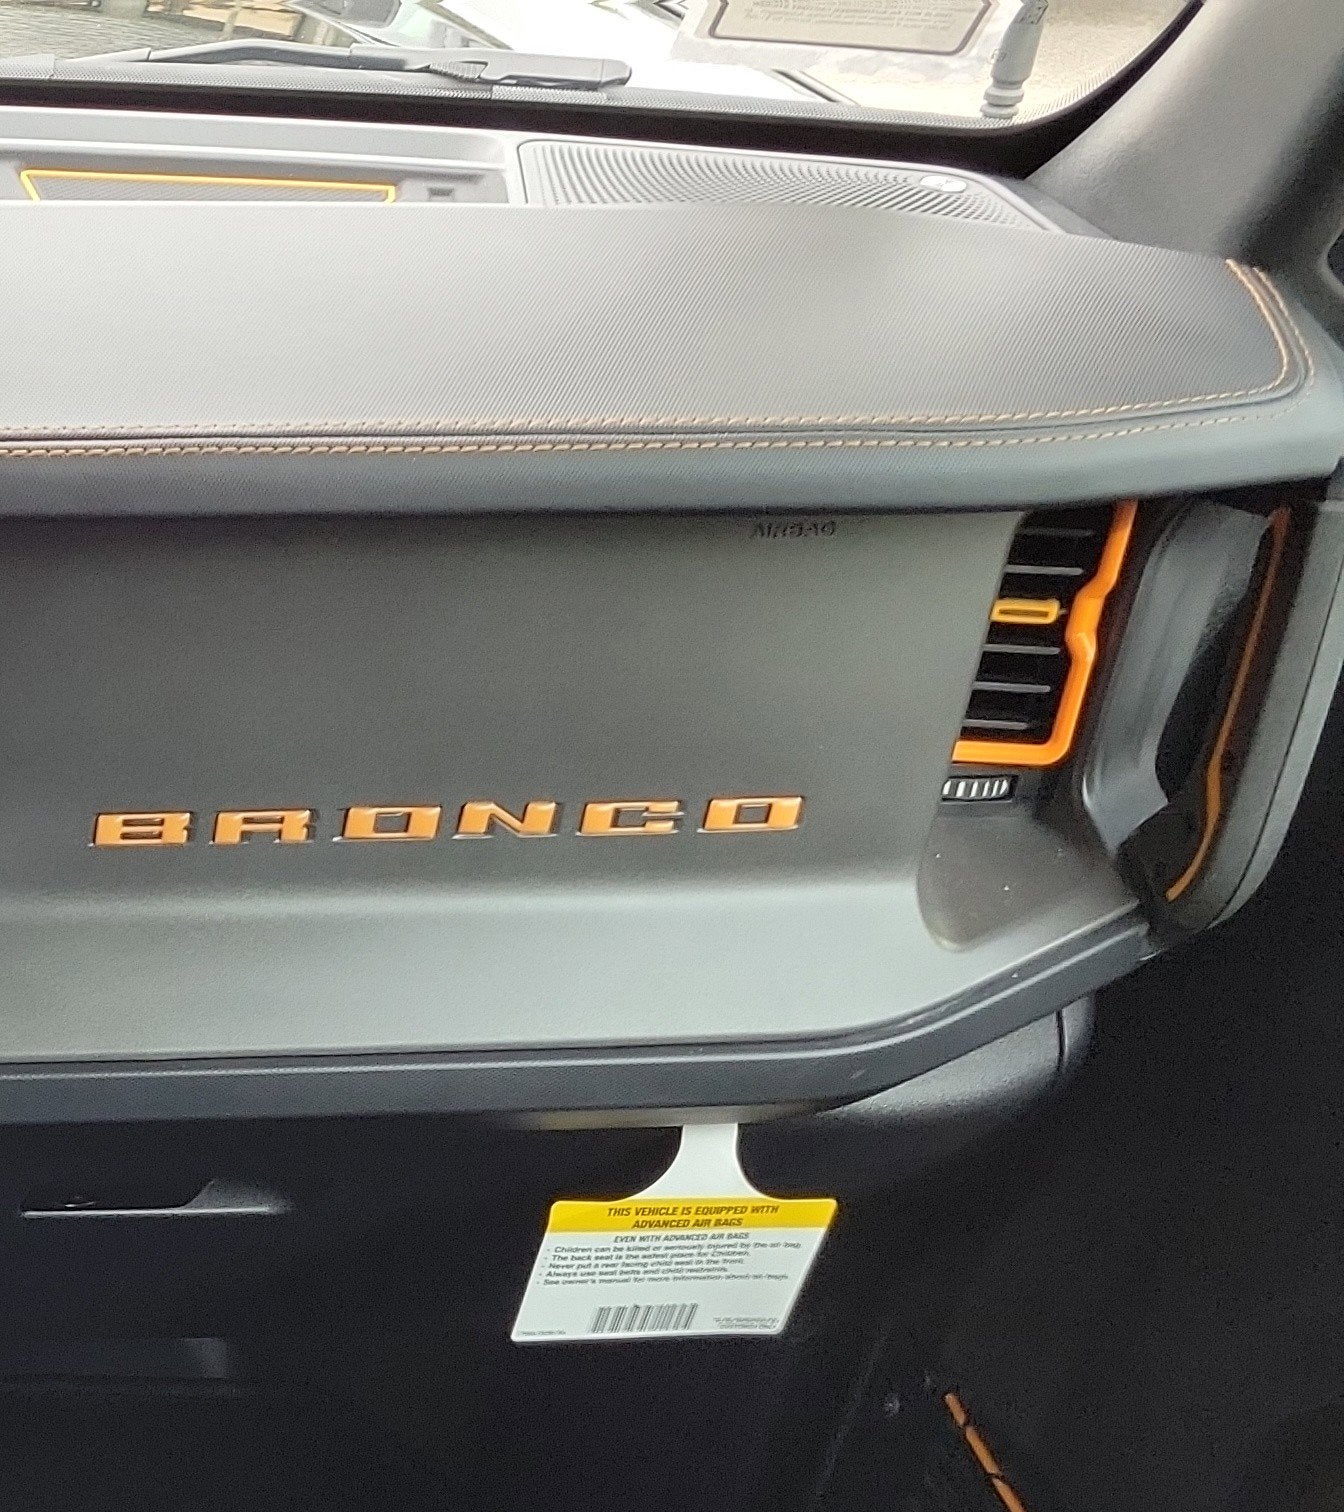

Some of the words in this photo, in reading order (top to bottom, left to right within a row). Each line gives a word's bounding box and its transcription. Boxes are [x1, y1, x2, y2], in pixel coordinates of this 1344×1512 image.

[88, 796, 803, 847] BRONCO
[608, 1207, 631, 1216] THIS
[634, 1206, 680, 1216] VEHICLE
[681, 1206, 692, 1216] IS
[695, 1206, 748, 1216] EQUIPPED
[750, 1205, 779, 1214] WITH
[632, 1218, 690, 1228] ADVANCED
[692, 1218, 712, 1228] AIR
[714, 1218, 744, 1227] BAGS
[664, 1234, 708, 1242] ADVANCED
[726, 1232, 750, 1240] BAGS
[554, 1246, 592, 1254] Children
[552, 1254, 569, 1262] The
[571, 1254, 592, 1262] back
